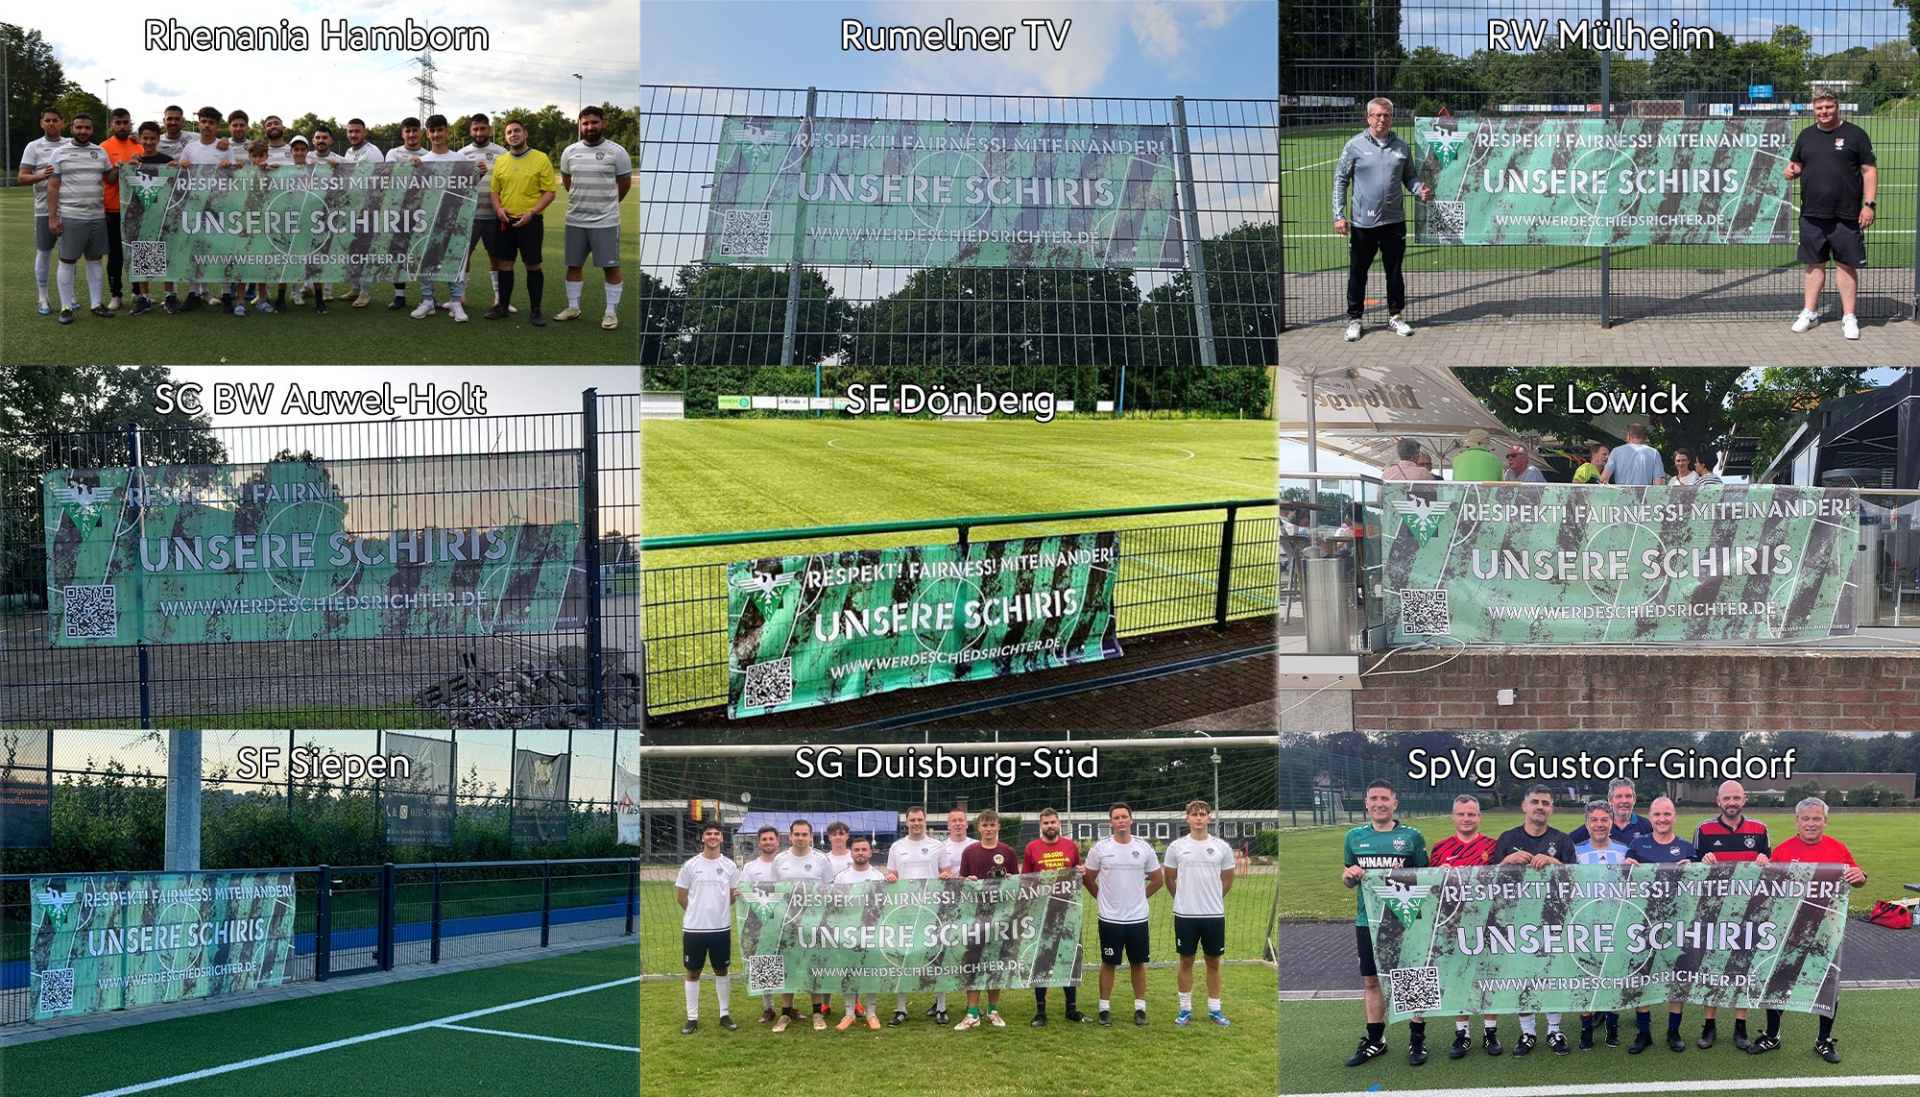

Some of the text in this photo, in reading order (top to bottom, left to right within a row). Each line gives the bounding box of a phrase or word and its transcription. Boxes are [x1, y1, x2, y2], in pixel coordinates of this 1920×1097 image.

[795, 132, 1165, 156] RESPEKT! FAIRNESS! MITEINANDER!
[1478, 132, 1786, 149] RESPEKT! FAIRNESS! MITEINANDER!
[176, 175, 474, 191] RESPEKT! FAIRNESS! MITEINANDER!
[799, 171, 1115, 207] UNSERE SCHIRIS
[1483, 167, 1739, 195] UNSERE SCHIRIS
[182, 208, 428, 235] UNSERE SCHIRIS
[1495, 214, 1724, 228] WWW.WERDESCHIEDSRICHTER.DE
[810, 225, 1099, 245] WWW.WERDESCHIEDSRICHTER.DE
[194, 252, 414, 265] WWW.WERDESCHIEDSRICHTER.DE
[1463, 498, 1851, 525] RESPEKT! FAIRNESS! MITEINANDER!
[139, 526, 508, 573] UNSERE SCHIRIS
[1471, 543, 1793, 582] UNSERE SCHIRIS
[807, 547, 1114, 589] RESPEKT! FAIRNESS! MITEINANDER!
[160, 589, 488, 617] WWW.WERDESCHIEDSRICHTER.DE
[814, 588, 1077, 643] UNSERE SCHIRIS
[1488, 601, 1776, 620] WWW.WERDESCHIEDSRICHTER.DE
[830, 636, 1061, 680] WWW.WERDESCHIEDSRICHTER.DE
[1357, 856, 1406, 868] WINAMAX
[84, 884, 293, 908] RESPEKT! FAIRNESS! MITEINANDER!
[793, 879, 1077, 907] RESPEKT! FAIRNESS! MITEINANDER!
[1443, 878, 1840, 902] RESPEKT! FAIRNESS! MITEINANDER!
[88, 916, 265, 958] UNSERE SCHIRIS
[797, 914, 1036, 949] UNSERE SCHIRIS
[1457, 919, 1778, 956] UNSERE SCHIRIS
[98, 961, 257, 991] WWW.WERDESCHIEDSRICHTER.DE
[811, 959, 1025, 978] WWW.WERDESCHIEDSRICHTER.DE
[1478, 969, 1756, 992] WWW.WERDESCHIEDSRICHTER.DE
